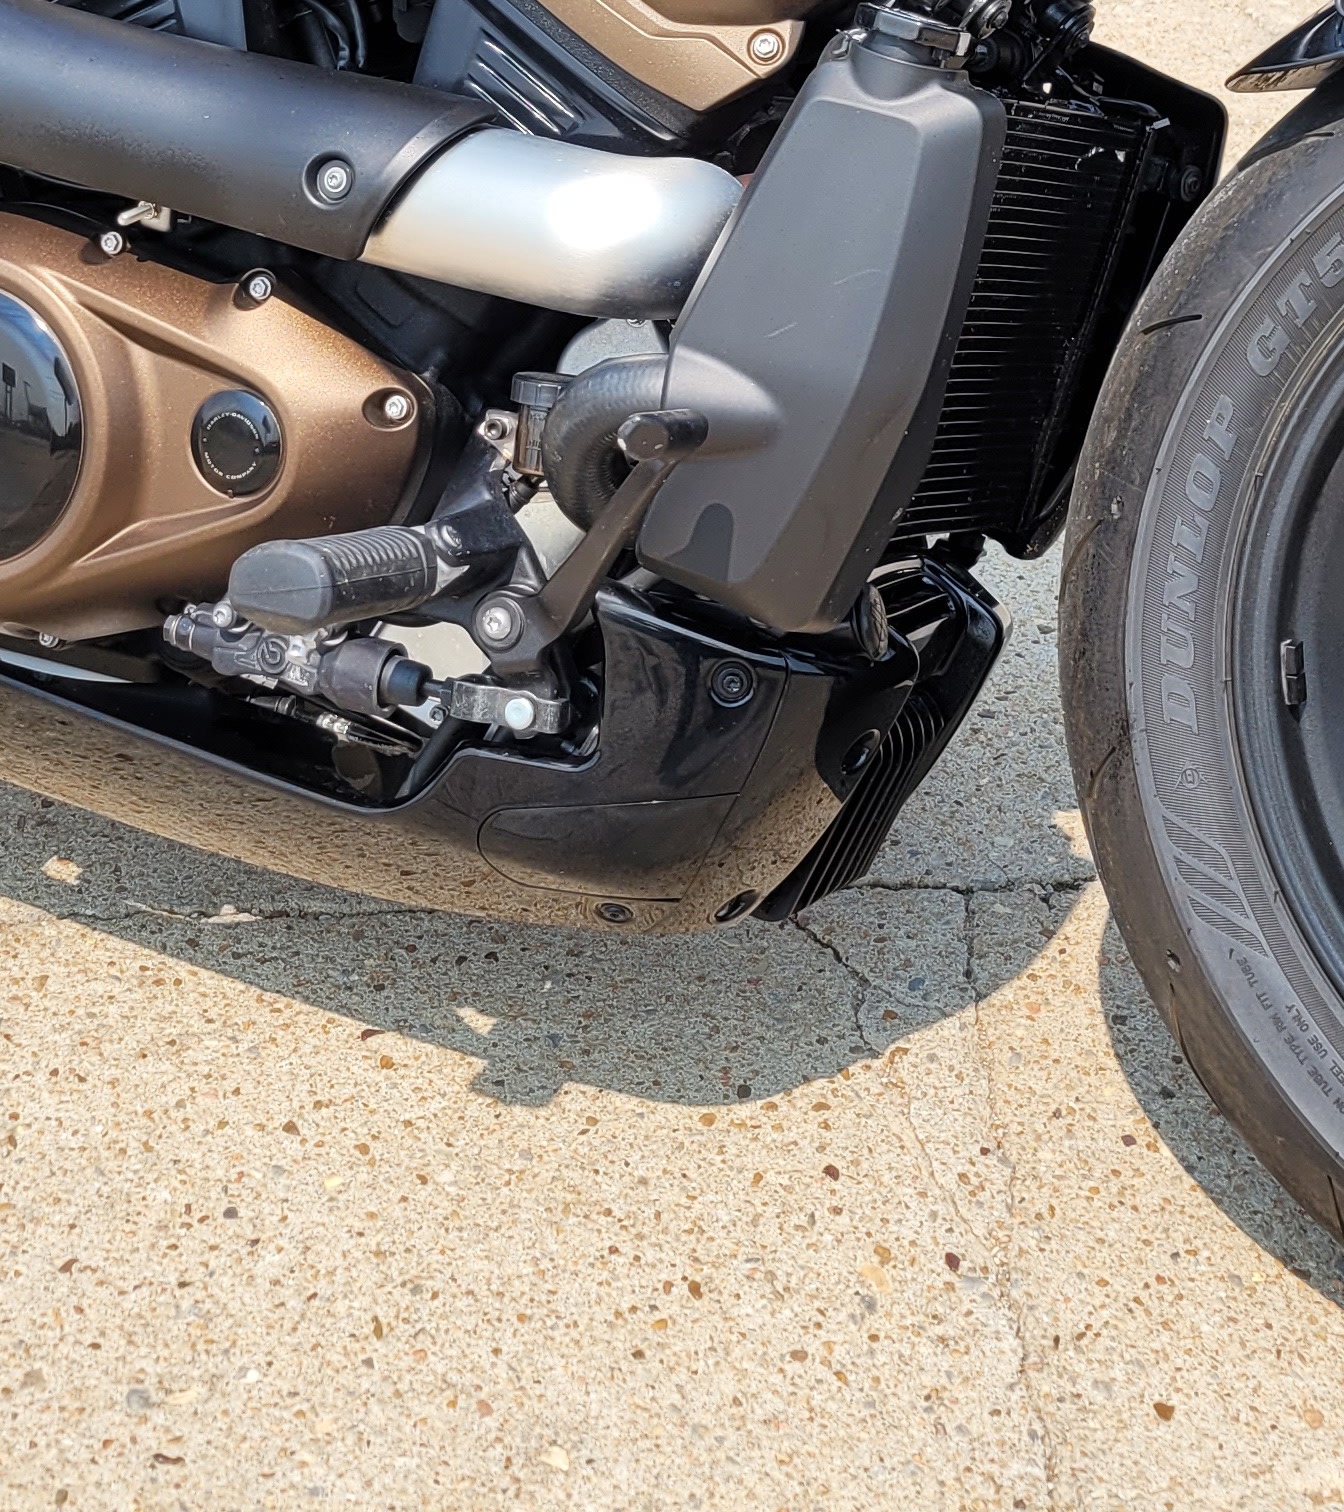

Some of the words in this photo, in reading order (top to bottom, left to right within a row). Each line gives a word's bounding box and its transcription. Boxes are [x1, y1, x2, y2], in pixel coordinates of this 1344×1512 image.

[225, 460, 257, 480] COMPANY
[1161, 392, 1239, 736] DUNLOP
[1236, 955, 1258, 988] TUBE
[1284, 1002, 1310, 1033] ONLY
[1283, 1034, 1308, 1066] TYPE
[1307, 1033, 1329, 1059] USE
[1307, 1065, 1335, 1098] TUBE
